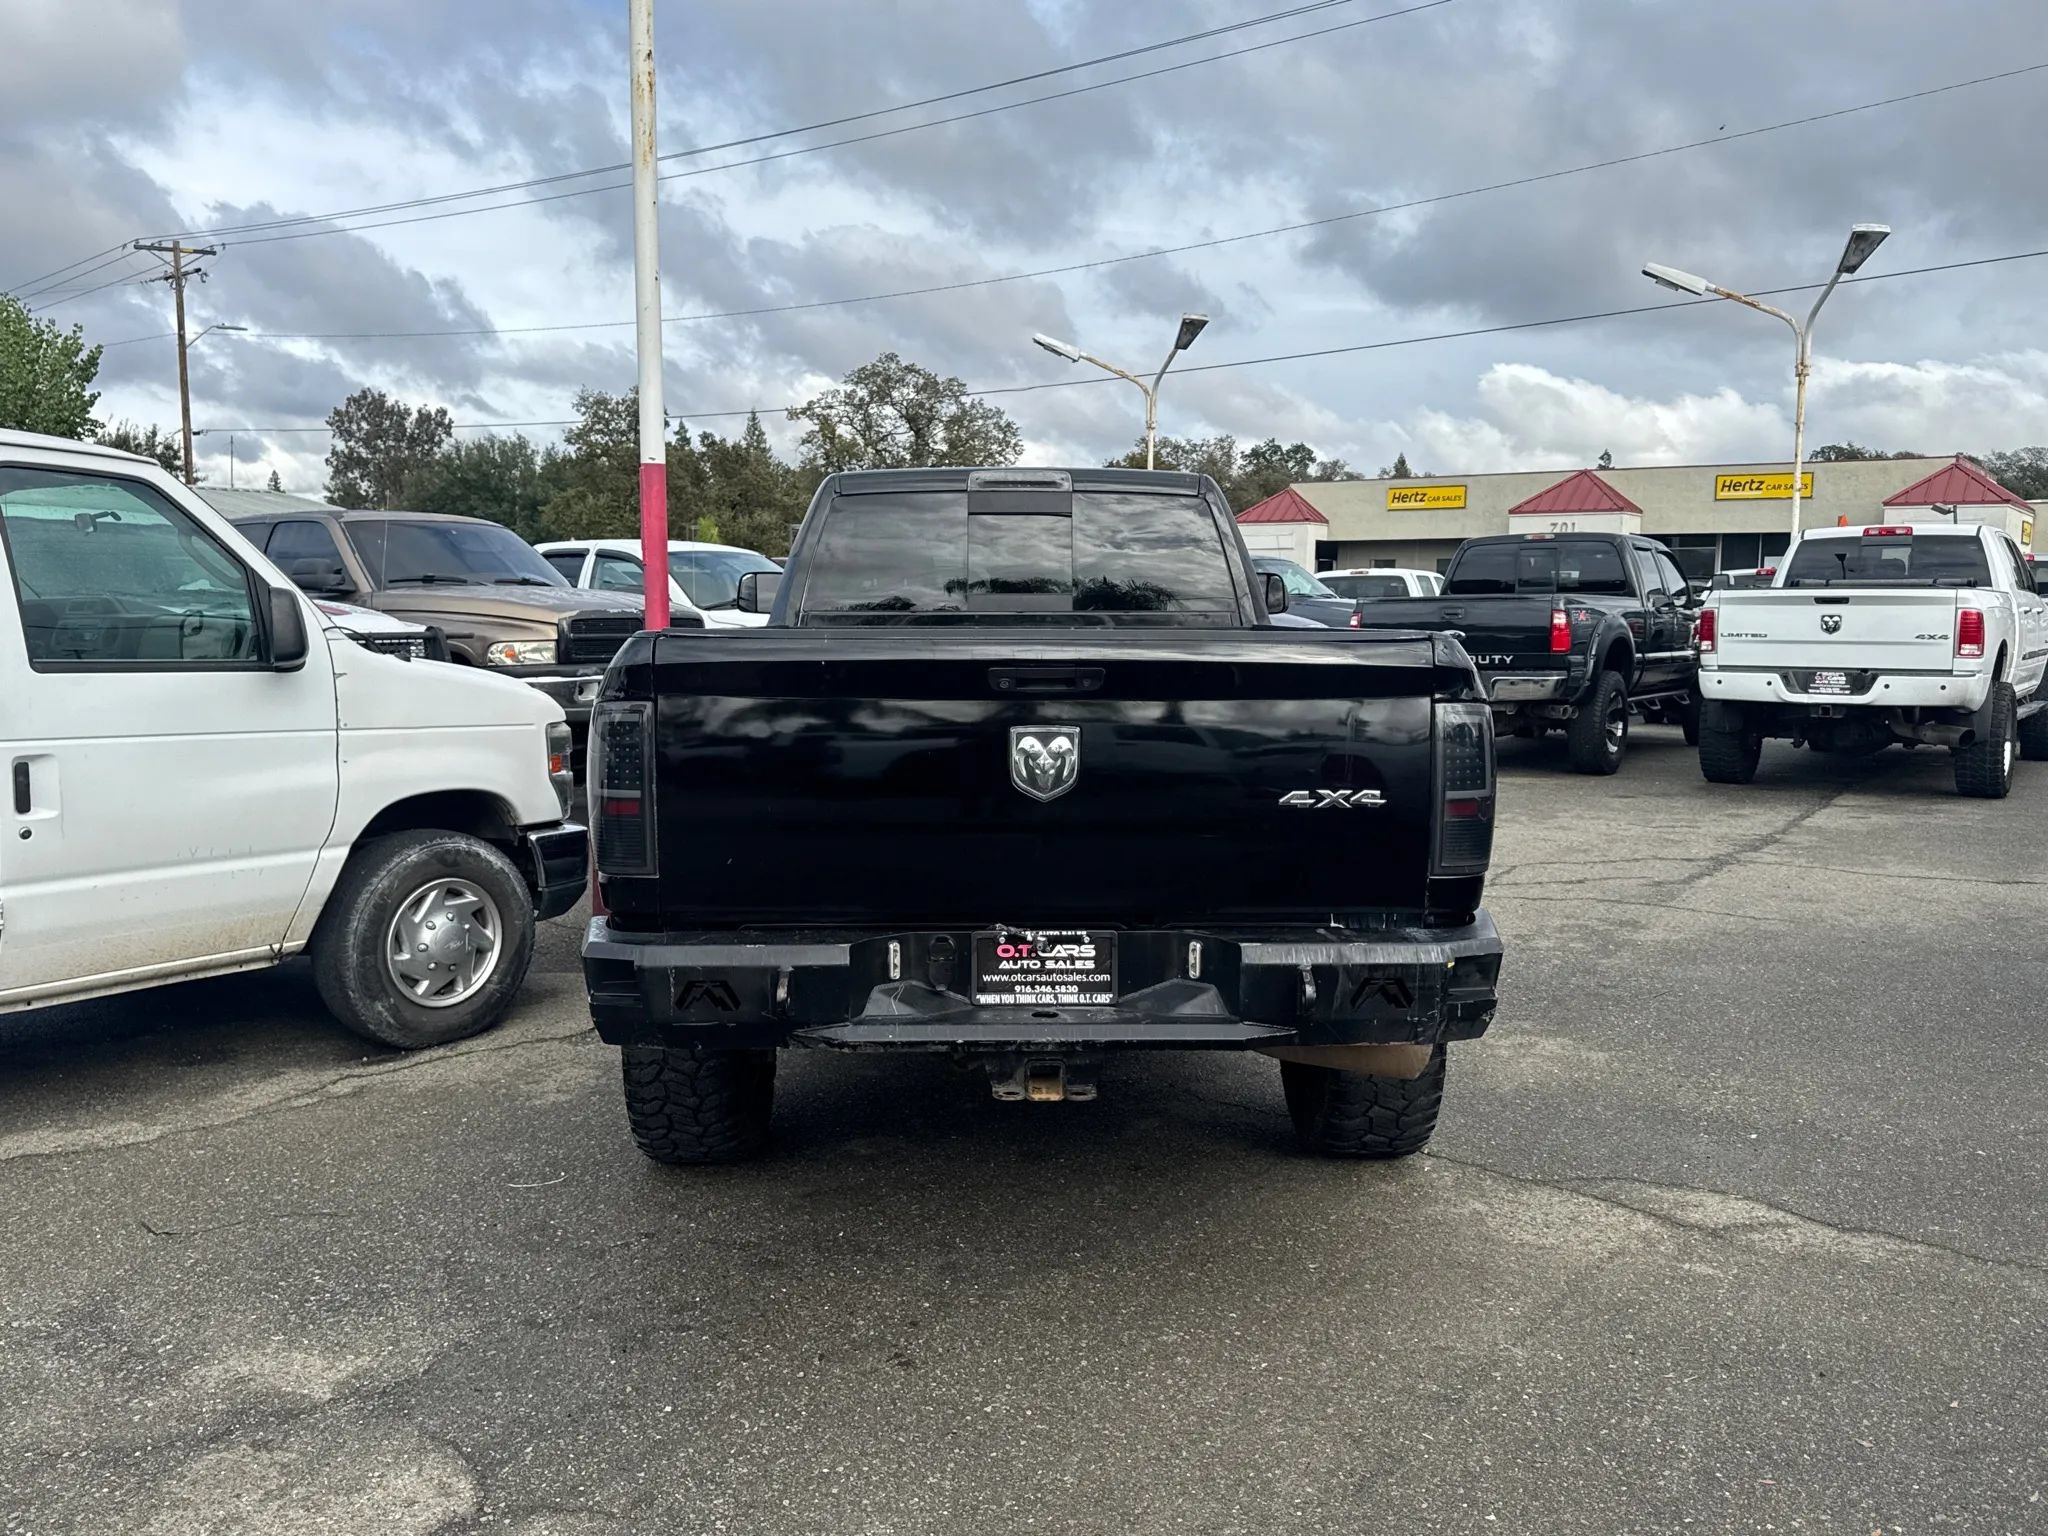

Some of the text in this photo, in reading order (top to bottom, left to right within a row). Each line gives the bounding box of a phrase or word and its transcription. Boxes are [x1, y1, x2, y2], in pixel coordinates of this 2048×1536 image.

[1721, 478, 1765, 492] Hertz
[1391, 491, 1427, 503] Hertz
[998, 960, 1096, 969] AUTO SALES
[982, 972, 1111, 982] www.otcarsautosales.com
[1014, 985, 1079, 993] 916.346.5830
[1000, 994, 1015, 1004] YOU
[1016, 994, 1037, 1004] THINK
[1037, 994, 1057, 1005] CARS,
[1057, 994, 1079, 1004] THINK
[1079, 994, 1092, 1004] O.T.
